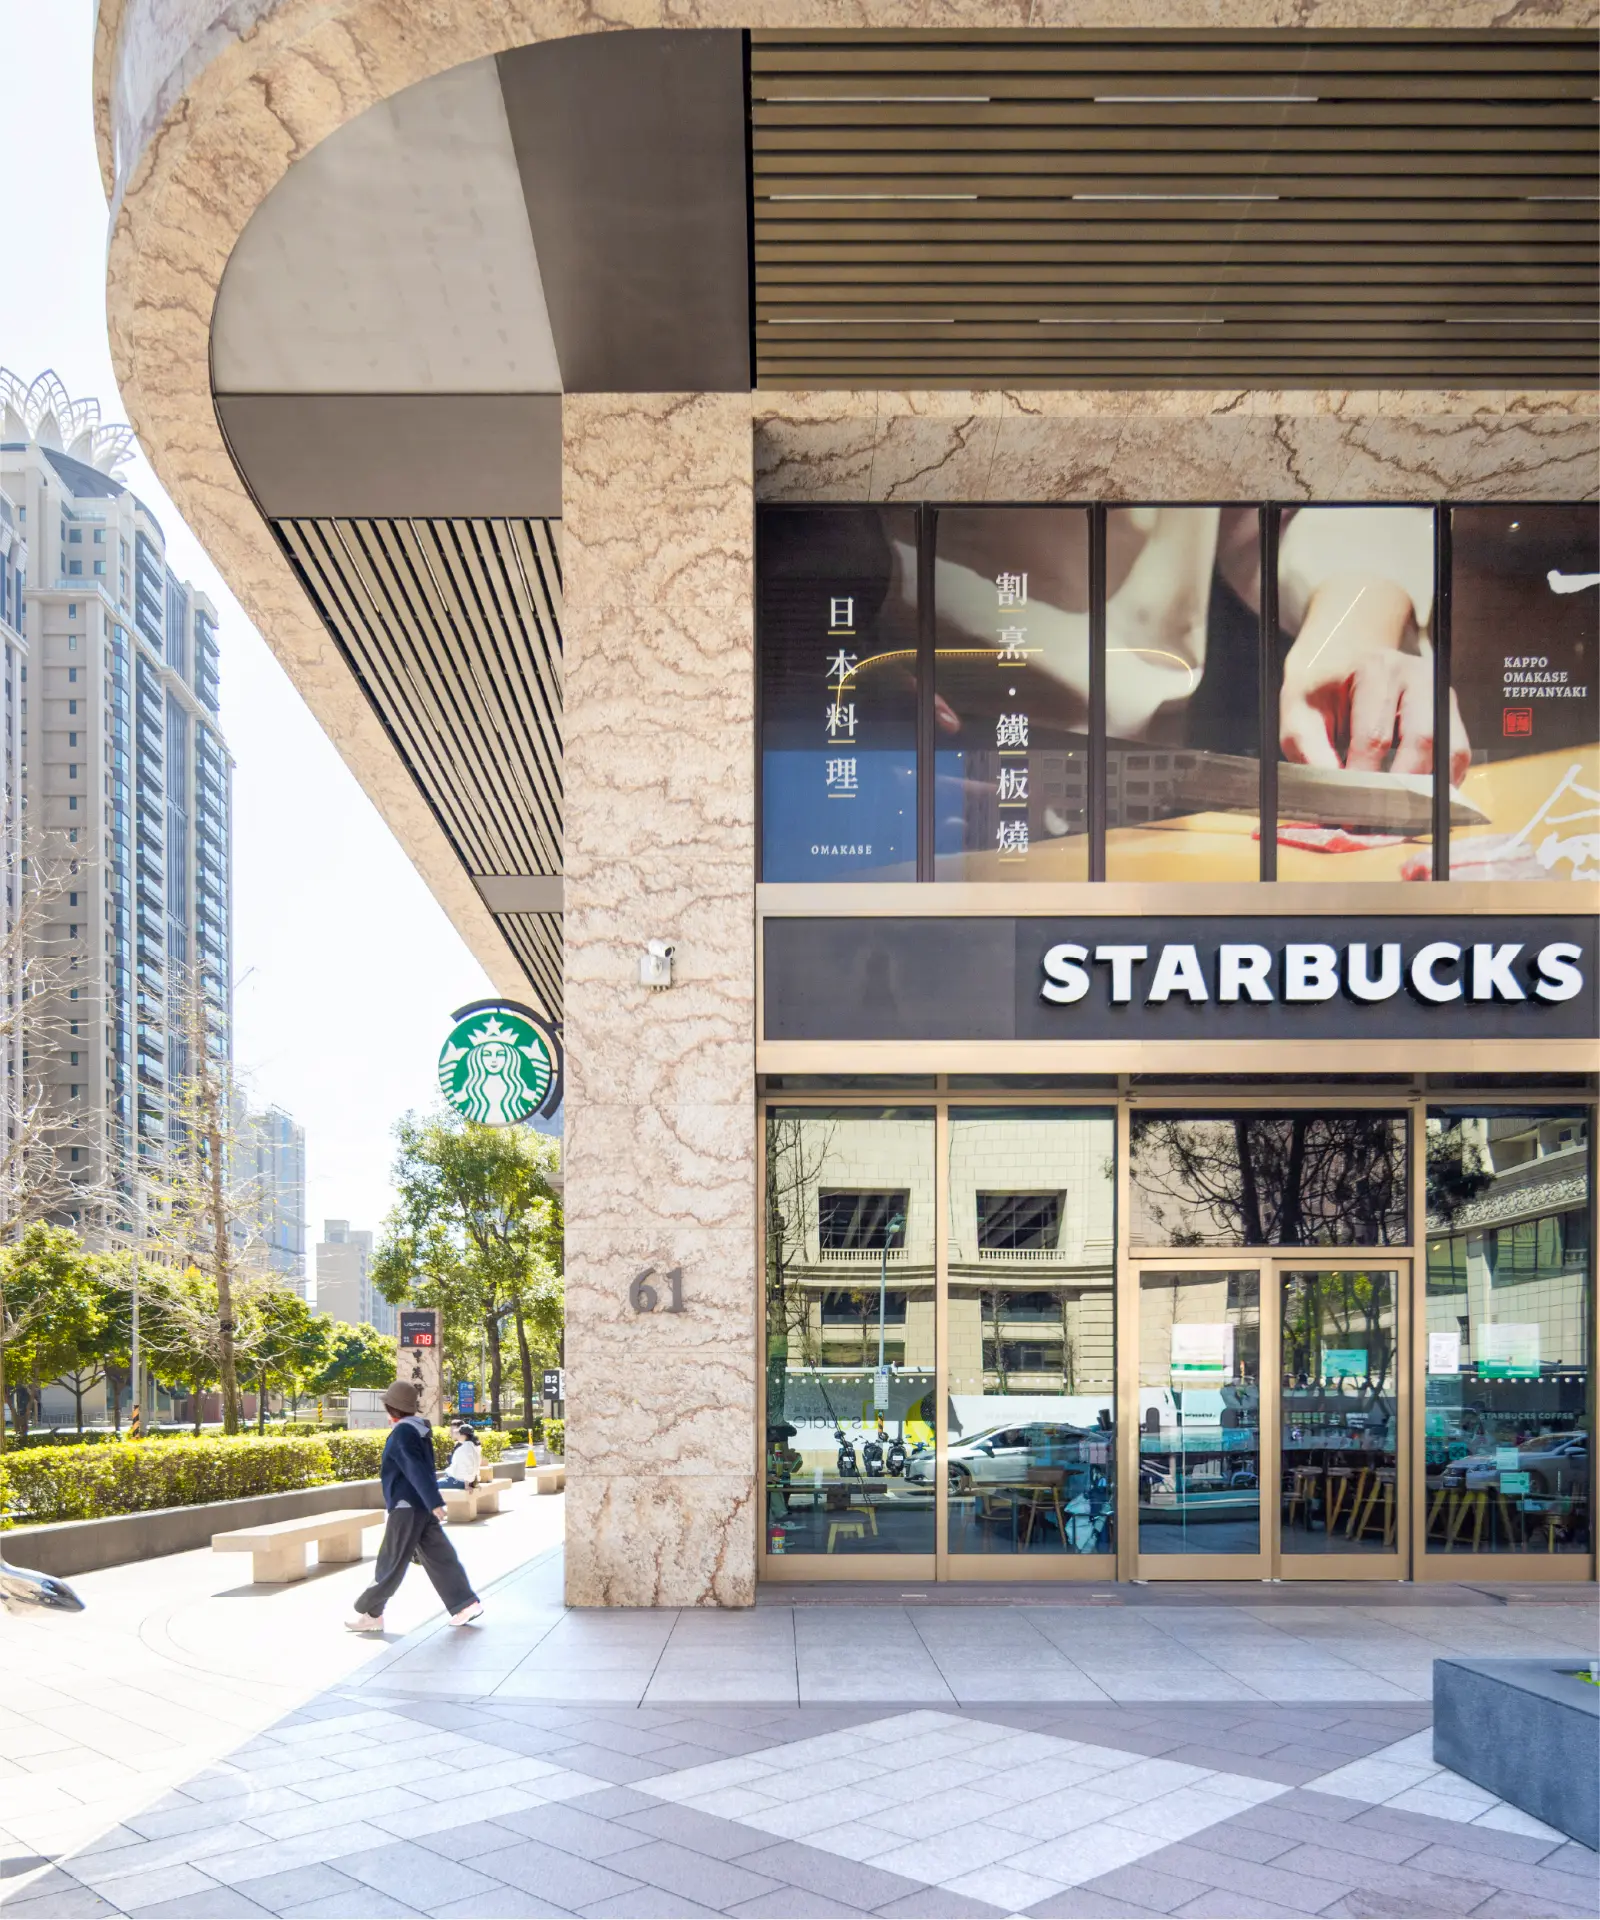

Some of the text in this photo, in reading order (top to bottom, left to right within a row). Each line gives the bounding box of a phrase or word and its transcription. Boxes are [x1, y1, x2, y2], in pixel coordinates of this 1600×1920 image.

[1503, 656, 1548, 668] KAPPO
[1503, 671, 1568, 683] OMAKASE
[825, 596, 859, 791] 日本料理
[1503, 686, 1588, 698] TEPPANYAKI
[811, 844, 873, 856] OMAKASE
[1041, 941, 1585, 1003] STARBUCKS
[629, 1267, 687, 1313] 61
[415, 1334, 432, 1345] 178
[544, 1375, 558, 1384] B2
